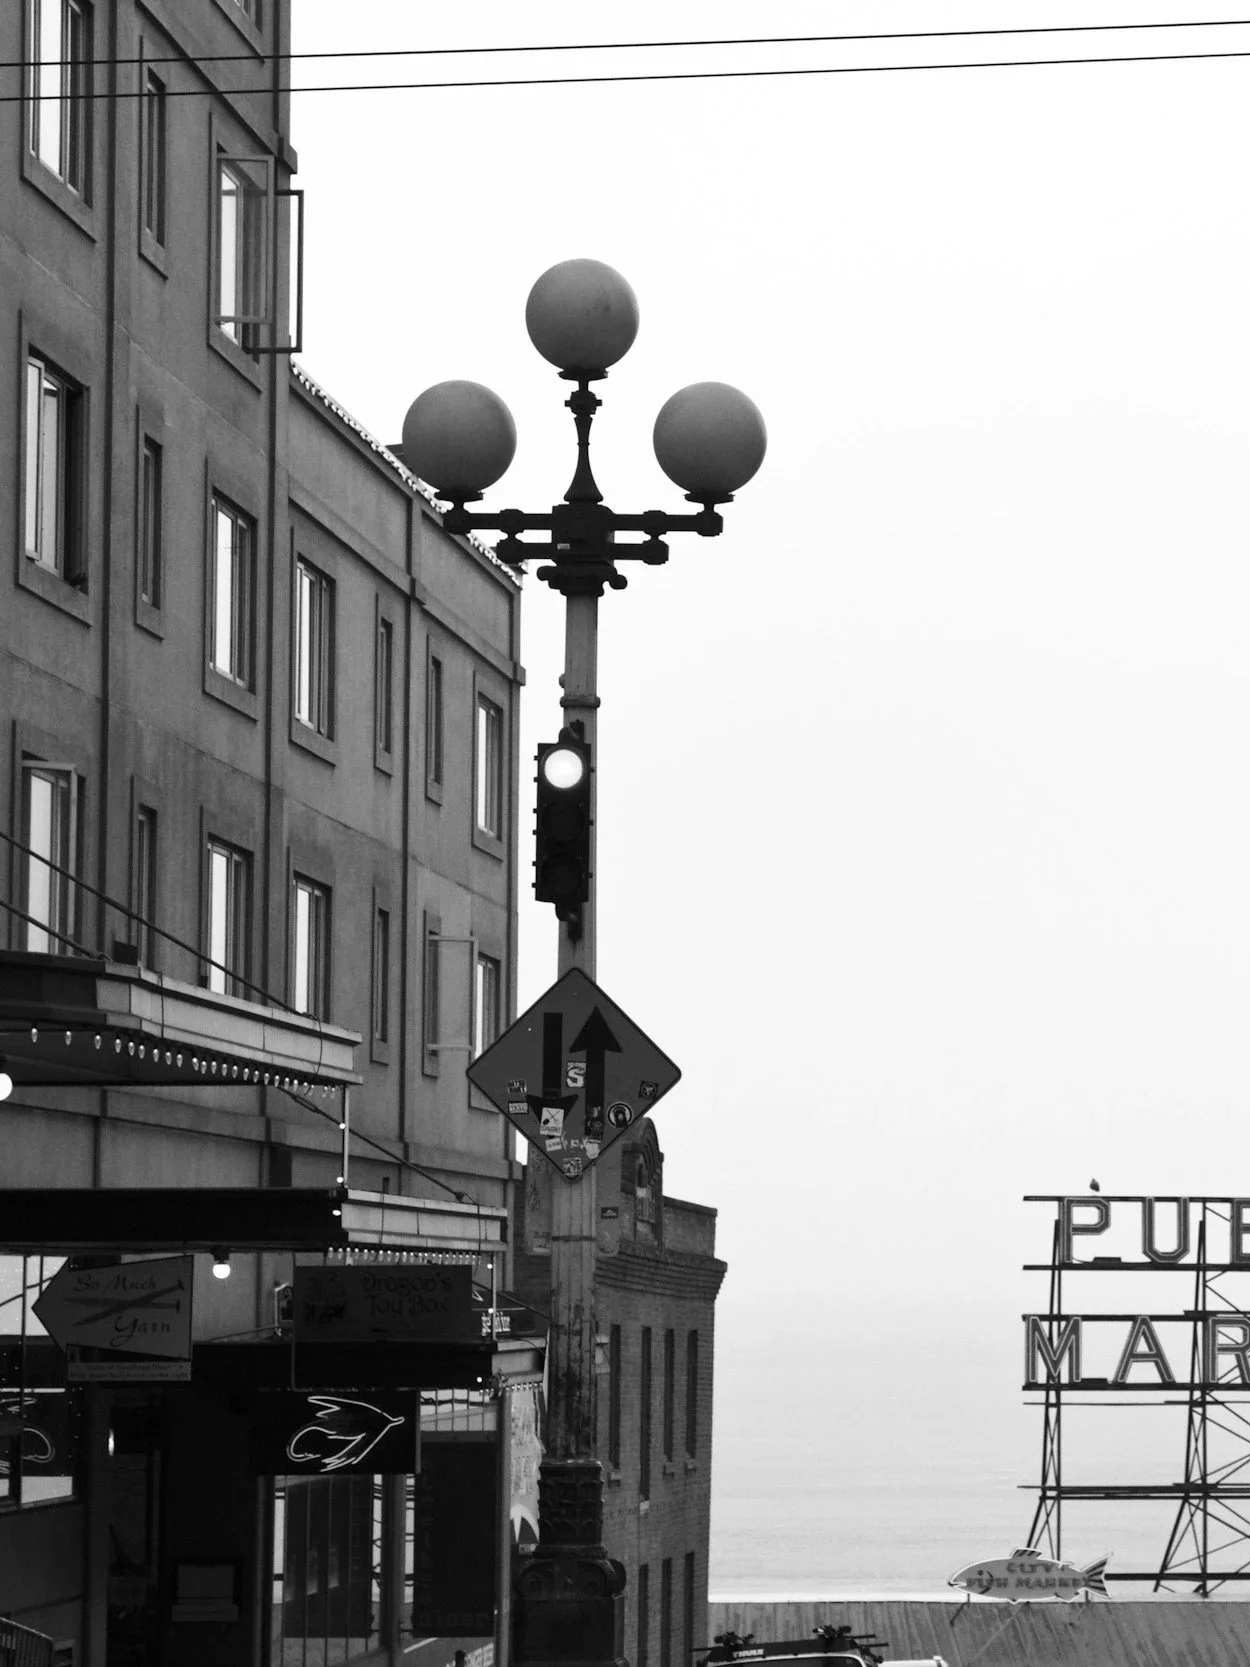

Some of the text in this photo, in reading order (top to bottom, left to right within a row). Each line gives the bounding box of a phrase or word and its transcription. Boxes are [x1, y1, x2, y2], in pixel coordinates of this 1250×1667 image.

[74, 1273, 157, 1293] So Much
[358, 1272, 452, 1296] Dragon's
[365, 1293, 449, 1318] Toy Box
[110, 1315, 170, 1347] Yarn
[1006, 1562, 1055, 1574] CITY
[966, 1577, 1089, 1589] FISH MARKET
